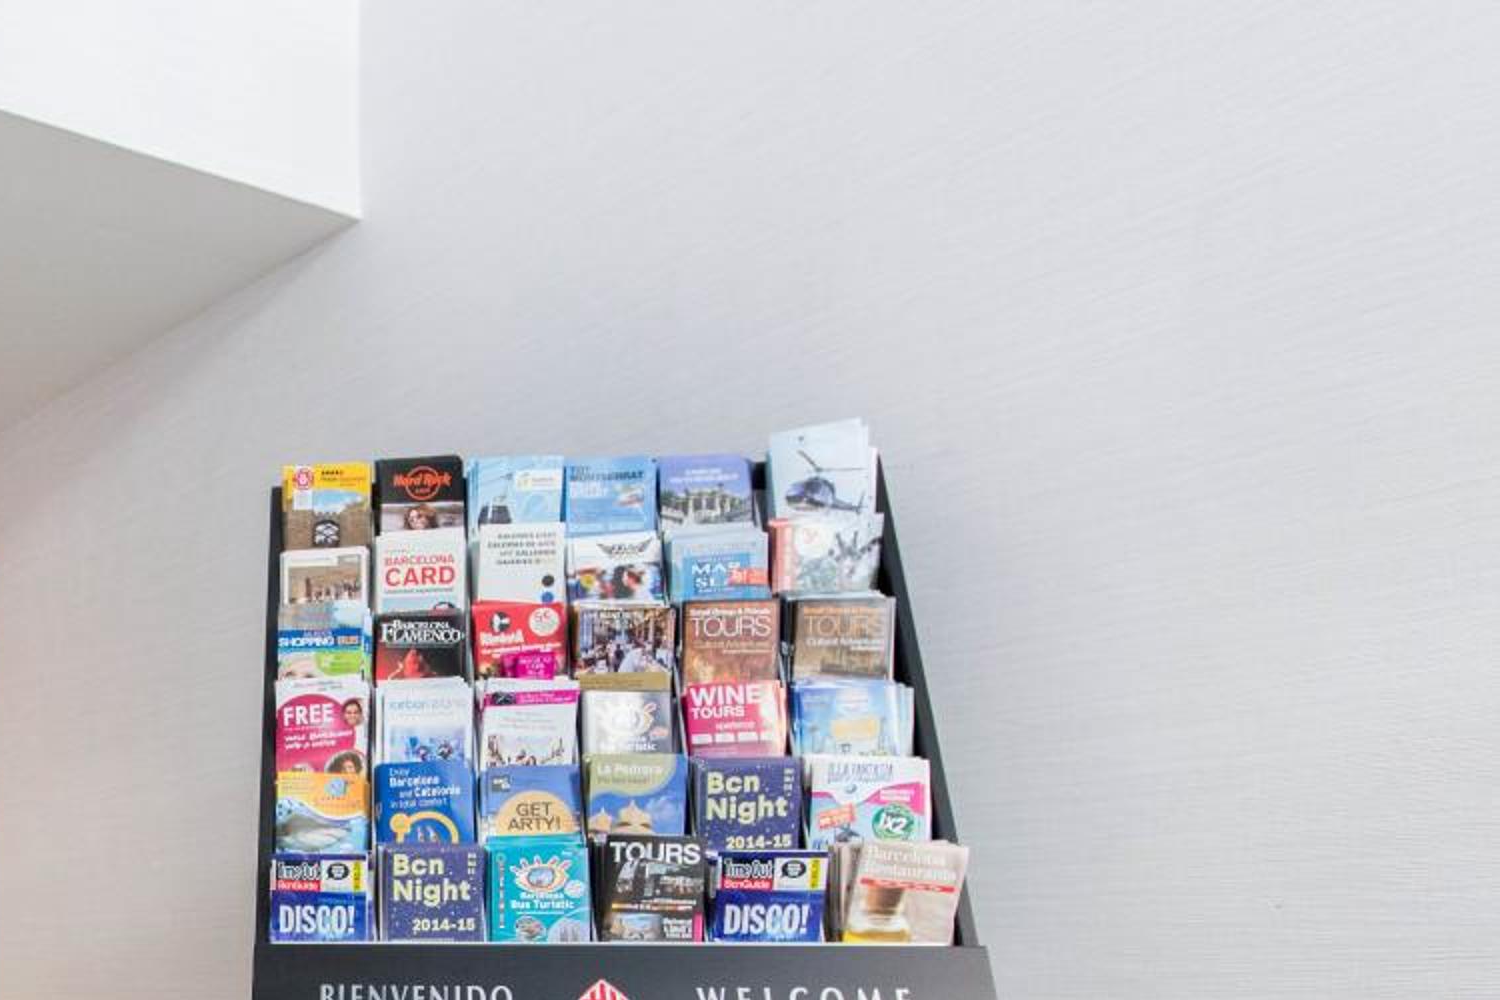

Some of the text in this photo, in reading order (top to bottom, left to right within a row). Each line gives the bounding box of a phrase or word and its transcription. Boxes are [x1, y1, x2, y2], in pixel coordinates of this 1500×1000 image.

[393, 471, 452, 487] Hard Rock
[384, 554, 455, 567] BARCELONA
[385, 566, 456, 587] CARD
[381, 623, 462, 643] FLAMENCO
[392, 619, 451, 631] BARCELONA
[691, 615, 772, 638] TOURS
[804, 615, 885, 638] TOURS
[278, 637, 335, 647] SHOPPING
[690, 684, 763, 705] WINE
[283, 704, 334, 727] FREE
[690, 706, 745, 720] TOURS
[389, 775, 440, 789] Barcelona
[705, 771, 761, 794] Bcn
[516, 801, 552, 817] GET
[705, 795, 789, 825] Night
[507, 816, 561, 832] ARTY!
[726, 834, 792, 850] 2014-15
[609, 842, 701, 865] TOURS
[392, 853, 444, 876] Bcn
[724, 859, 753, 878] Time
[753, 859, 773, 878] Out
[392, 879, 472, 907] Night
[723, 879, 771, 890] BcnGuide
[510, 899, 532, 909] Bus
[279, 904, 356, 935] DISCO!
[411, 917, 476, 933] 2014-15
[723, 903, 811, 935] DISCO!
